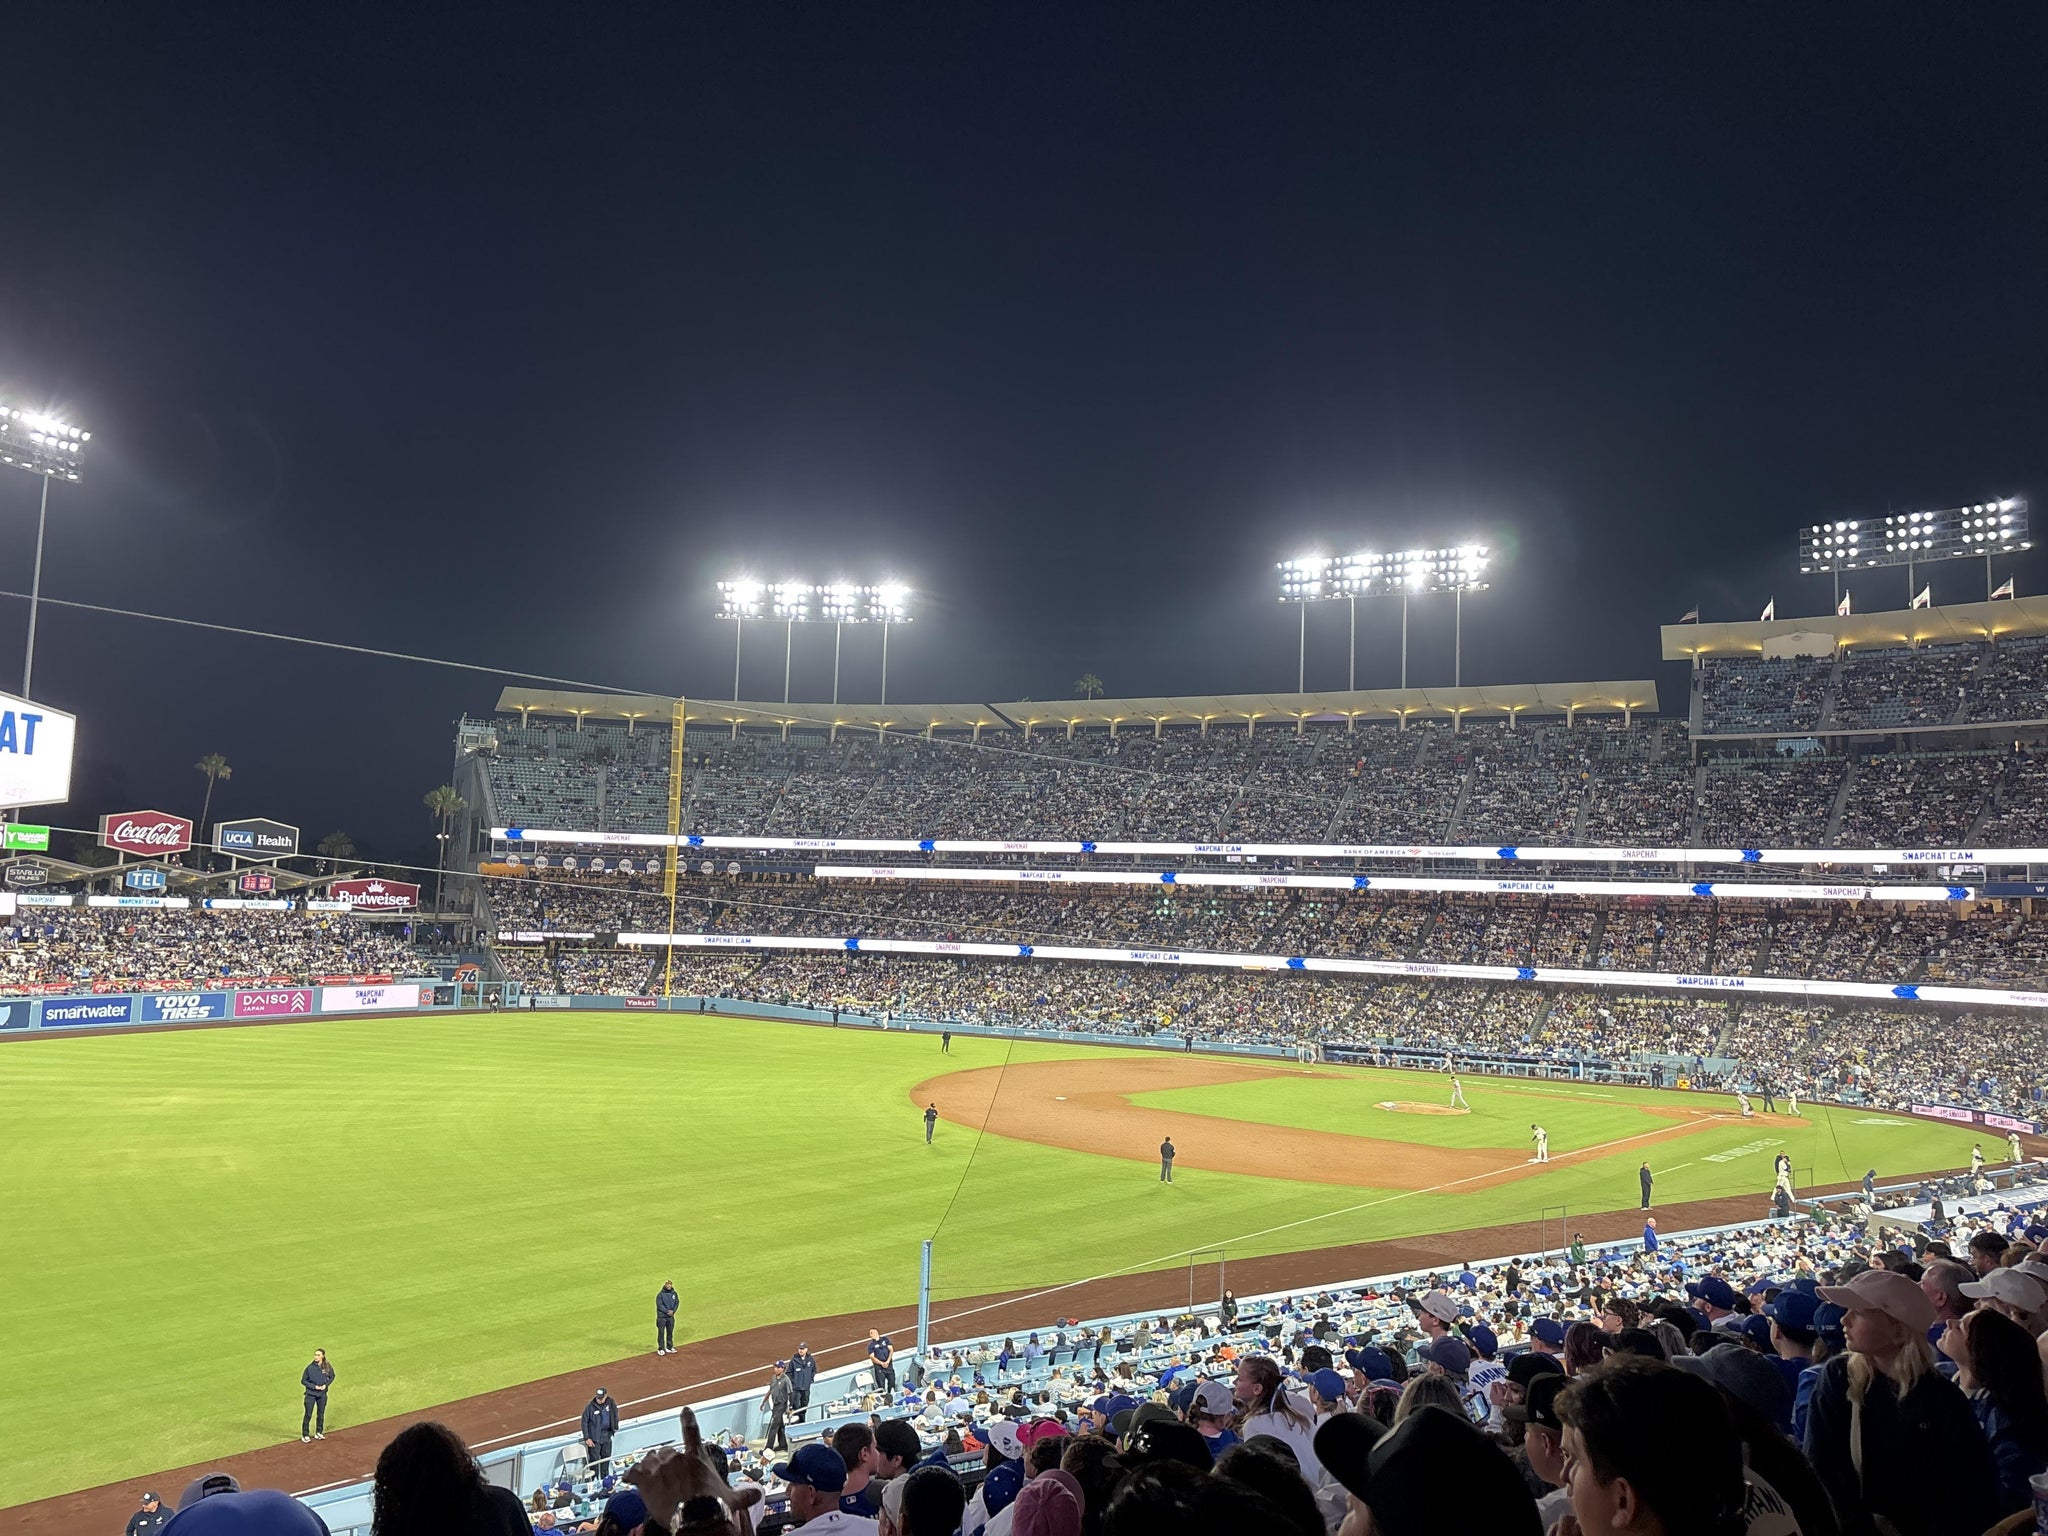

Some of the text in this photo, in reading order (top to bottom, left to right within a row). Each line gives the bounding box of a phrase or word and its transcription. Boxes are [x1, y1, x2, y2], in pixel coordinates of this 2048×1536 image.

[113, 820, 185, 846] Coca-Cola
[226, 833, 292, 847] UCLA Health
[1225, 845, 1242, 853] CAM
[1622, 850, 1658, 859] SNAPCHAT
[1902, 852, 1973, 860] SNAPCHAT CAM
[9, 868, 46, 877] STARLUX
[132, 873, 161, 887] TEL
[1498, 882, 1555, 891] SNAPCHAT CAM
[1822, 887, 1861, 897] SNAPCHAT
[338, 890, 411, 906] Budweiser
[704, 936, 734, 944] SNAPCHAT
[935, 943, 961, 951] SNAPCHAT
[1130, 951, 1180, 961] SNAPCHAT CAM
[1404, 964, 1439, 973] SNAPCHAT
[459, 968, 478, 983] 76
[1676, 976, 1745, 987] SNAPCHAT CAM
[355, 989, 385, 998] SNAPCHAT
[421, 992, 432, 1002] 76
[155, 995, 200, 1008] TOYO
[243, 994, 289, 1006] DAISO
[361, 997, 378, 1005] CAM
[626, 999, 657, 1007] Yakult
[46, 1004, 127, 1021] smartwater
[161, 1006, 210, 1020] TIRES
